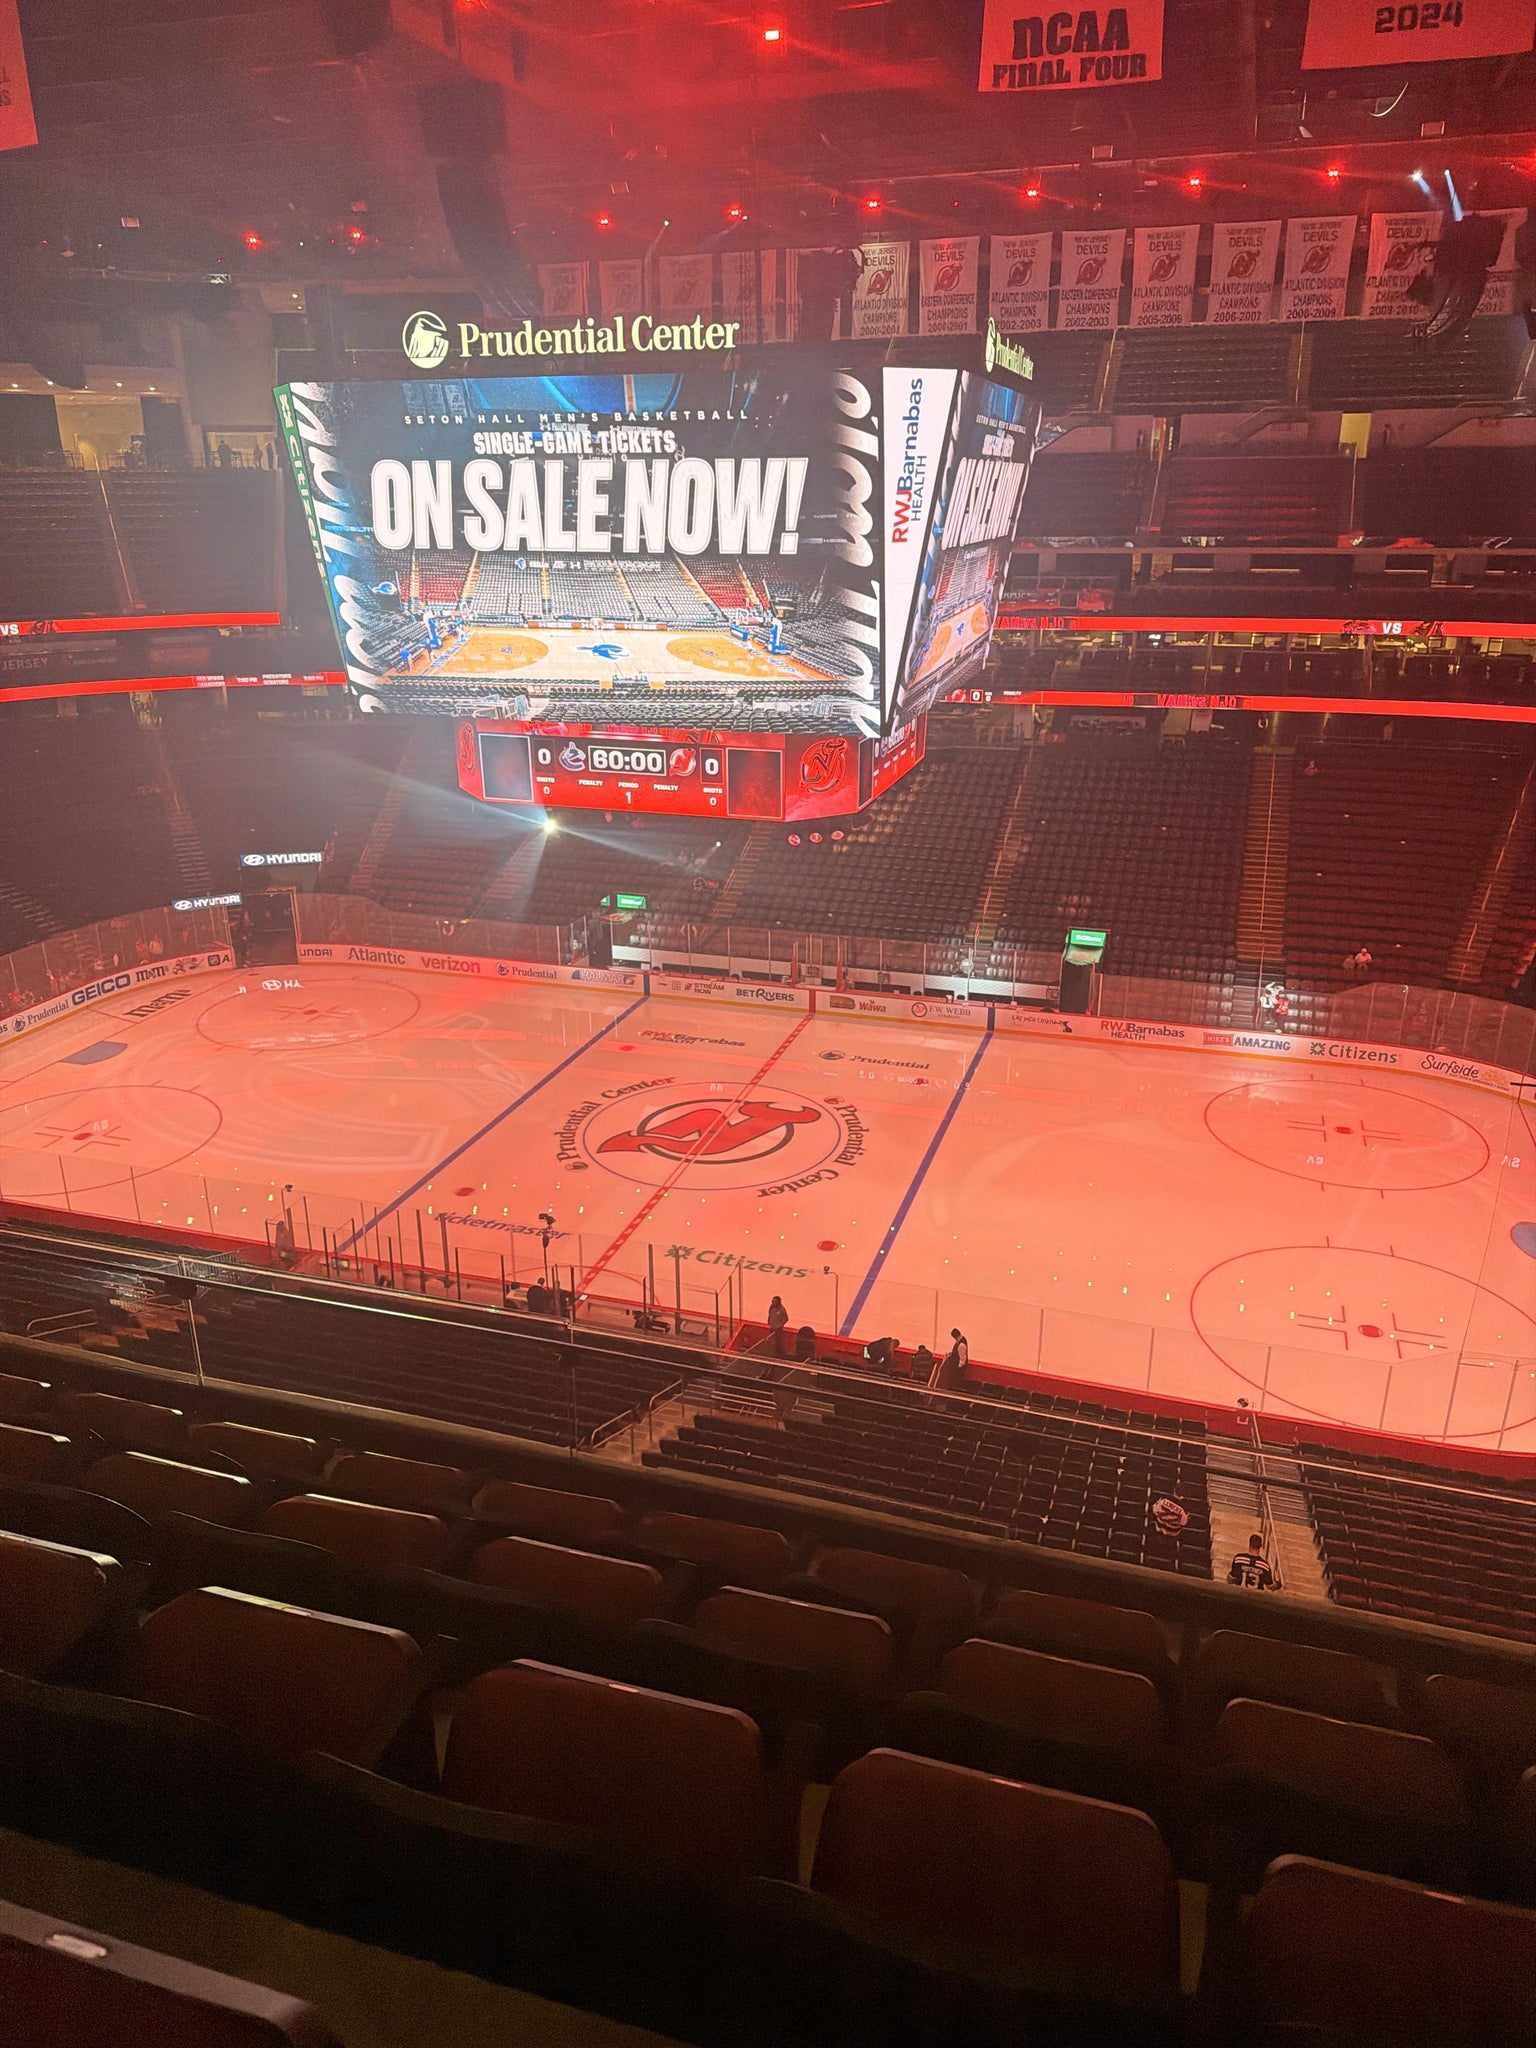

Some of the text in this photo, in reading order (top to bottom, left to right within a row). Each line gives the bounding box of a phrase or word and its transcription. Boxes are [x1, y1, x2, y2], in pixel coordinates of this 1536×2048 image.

[1374, 1, 1463, 34] 2024
[992, 54, 1146, 88] FINAL FOUR
[1303, 231, 1338, 242] DEVILS
[1386, 227, 1422, 239] DEVILS
[1150, 240, 1181, 252] DEVILS
[1229, 236, 1263, 248] DEVILS
[934, 250, 964, 262] DEVILS
[1006, 248, 1036, 259] DEVILS
[1076, 244, 1108, 255] DEVILS
[866, 254, 895, 266] DEVILS
[1211, 283, 1241, 295] ATLANTIC
[1284, 279, 1316, 291] ATLANTIC
[992, 291, 1019, 302] ATLANTIC
[1133, 286, 1163, 298] ATLANTIC
[854, 299, 881, 310] ATLANTIC
[1065, 303, 1111, 315] CHAMPIONS
[1142, 301, 1180, 313] CHAMPIONS
[1219, 297, 1259, 309] CHAMPIONS
[862, 312, 897, 324] CHAMPIONS
[927, 308, 968, 321] CHAMPIONS
[1000, 306, 1037, 318] CHAMPIONS
[1213, 311, 1262, 323] 2006-2007
[995, 320, 1042, 331] 2002-2003
[457, 314, 740, 357] Prudential Center
[996, 332, 1021, 375] Prudential
[405, 409, 748, 425] SETON HALL MEN'S BASKETBALL
[474, 430, 677, 455] SINGLE-GAME TICKETS
[891, 377, 923, 543] RWJBarnabas
[911, 455, 927, 521] HEALTH
[289, 434, 328, 578] Citizens
[371, 456, 808, 555] ON SALE NOW!
[0, 623, 19, 635] VS
[1382, 622, 1403, 634] VS
[2, 657, 48, 670] JERSEY
[972, 691, 980, 701] 0
[537, 748, 551, 765] 0
[592, 749, 663, 773] 60:00
[704, 758, 719, 775] 0
[536, 776, 555, 784] SHOTS
[578, 779, 603, 787] PENALTY
[618, 781, 639, 789] PERIOD
[543, 786, 550, 795] 0
[653, 783, 679, 792] PENALTY
[703, 787, 722, 795] SHOTS
[625, 791, 632, 805] 1
[266, 852, 322, 865] HYUNDAI
[193, 895, 241, 908] HYUNDAI
[348, 947, 406, 965] Atlantic
[421, 956, 481, 974] verizon
[511, 966, 557, 980] Prudential
[580, 970, 626, 985] HALMAR
[72, 974, 131, 1006] GEICO
[27, 999, 69, 1025] Prudential
[859, 1000, 887, 1013] Wawa
[945, 1007, 971, 1016] WEBB
[1100, 1019, 1185, 1039] RWJBarnabas
[1110, 1030, 1146, 1041] HEALTH
[651, 1036, 694, 1045] HEALTH
[1234, 1036, 1291, 1051] AMAZING
[1328, 1043, 1398, 1064] Citizens
[851, 1055, 930, 1070] Prudential
[1421, 1054, 1479, 1079] Surfside
[554, 1075, 676, 1162] Prudential Center
[756, 1103, 870, 1198] Prudential Center
[696, 1248, 810, 1279] Citizens
